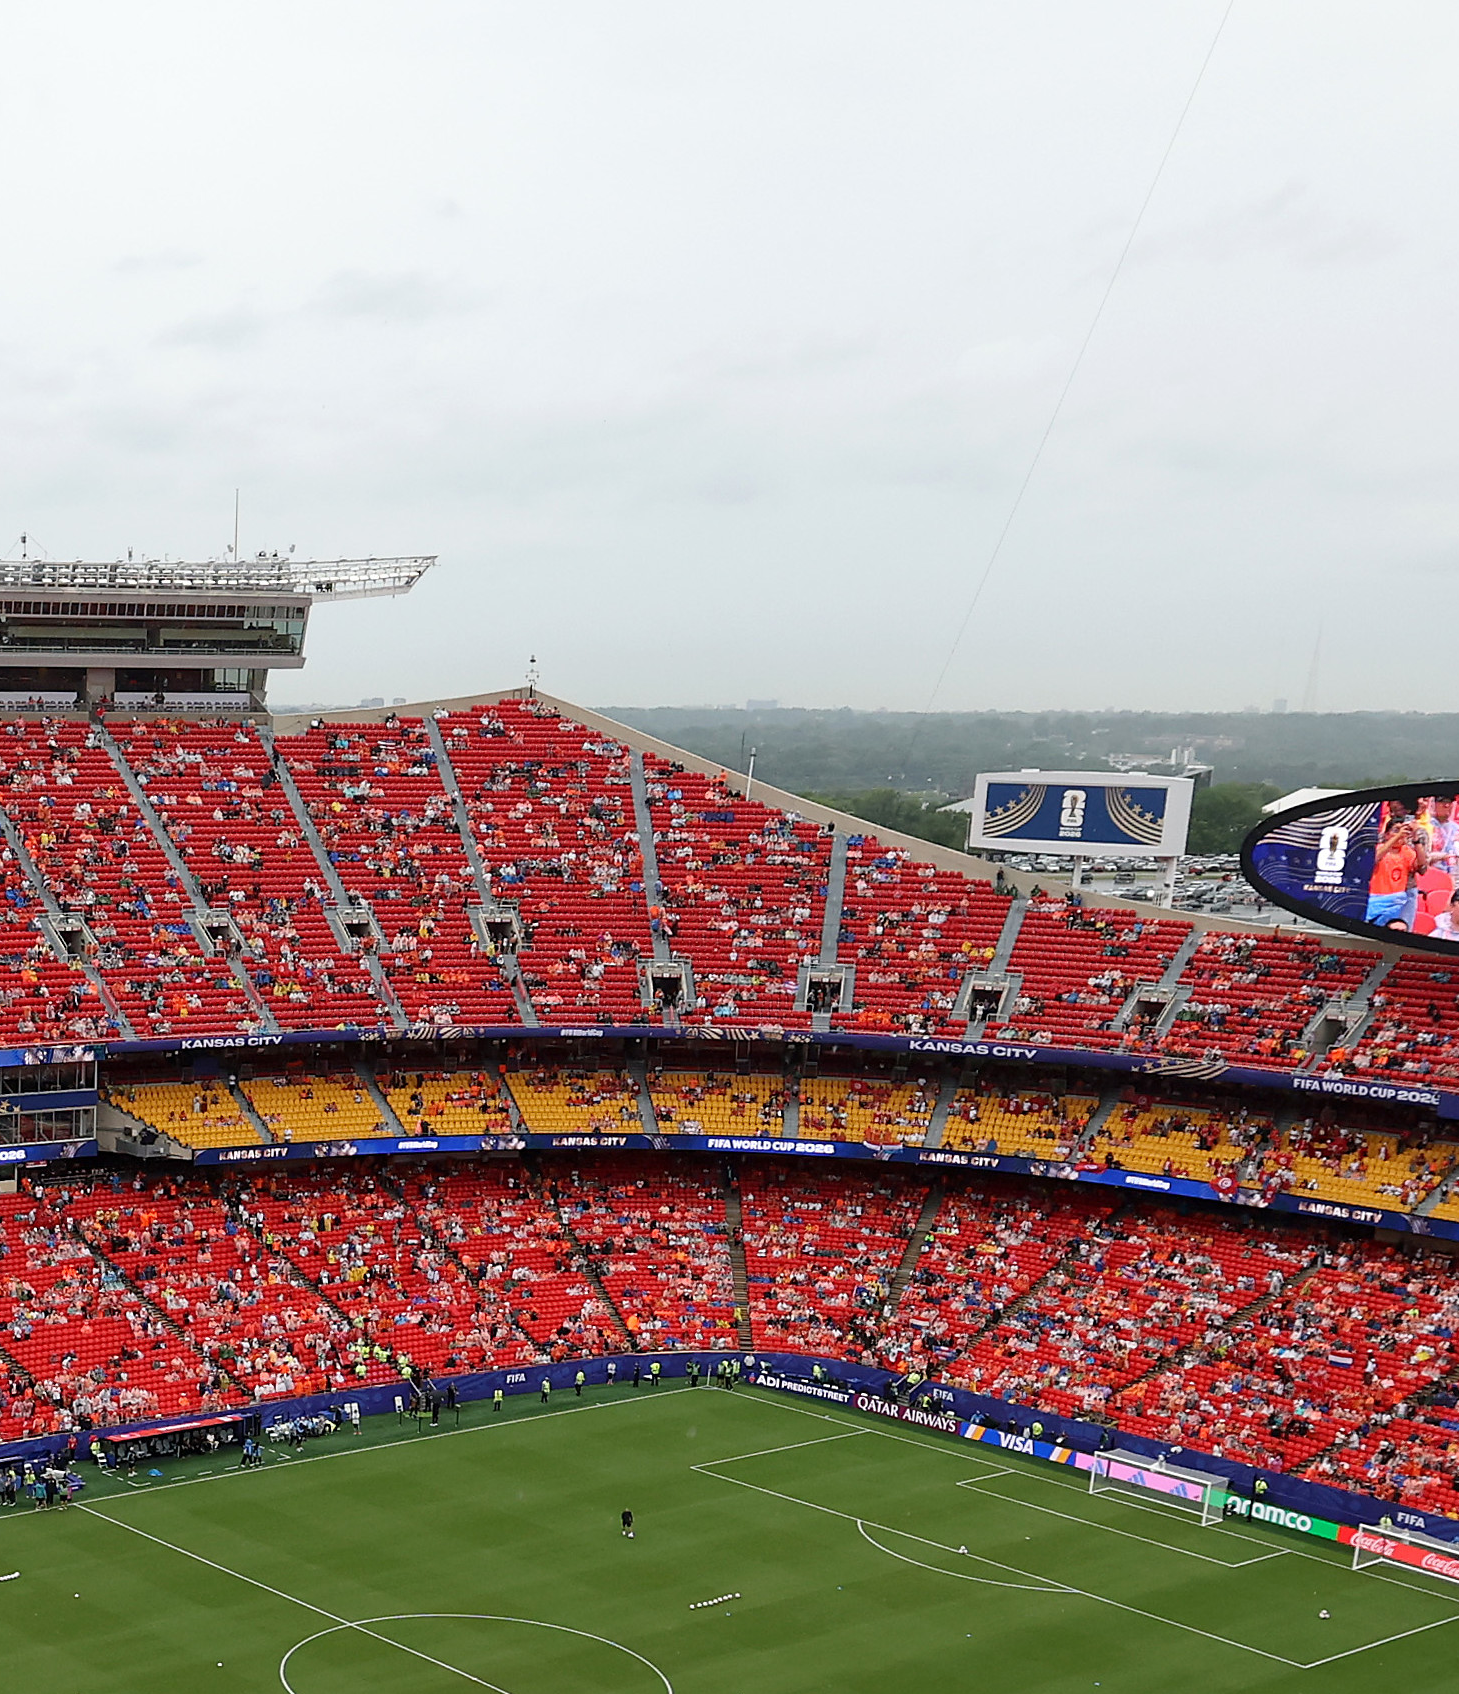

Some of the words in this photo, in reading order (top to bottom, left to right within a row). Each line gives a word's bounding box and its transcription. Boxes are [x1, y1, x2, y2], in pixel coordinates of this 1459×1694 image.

[181, 1037, 245, 1049] KANSAS
[247, 1036, 282, 1046] CITY
[909, 1040, 989, 1055] KANSAS
[992, 1046, 1037, 1059] CITY
[1293, 1078, 1322, 1092] FIFA
[1322, 1079, 1369, 1096] WORLD
[1369, 1086, 1396, 1099] CUP
[552, 1137, 599, 1147] KANSAS
[601, 1137, 627, 1146] CITY
[707, 1139, 733, 1149] FIFA
[733, 1140, 771, 1151] WORLD
[772, 1141, 795, 1152] CUP
[795, 1143, 834, 1154] 2026
[219, 1148, 262, 1161] KANSAS
[263, 1147, 288, 1158] CITY
[919, 1152, 969, 1165] KANSAS
[970, 1155, 999, 1168] CITY
[1298, 1201, 1349, 1219] KANSAS
[1352, 1210, 1383, 1224] CITY
[506, 1373, 526, 1384] FIFA
[781, 1379, 850, 1403] PREDICTSTREET
[932, 1388, 954, 1402] FIFA
[857, 1396, 899, 1418] QATAR
[902, 1408, 956, 1432] AIRWAYS
[998, 1431, 1034, 1455] VISA
[1227, 1496, 1313, 1532] aramco
[1396, 1511, 1426, 1529] FIFA
